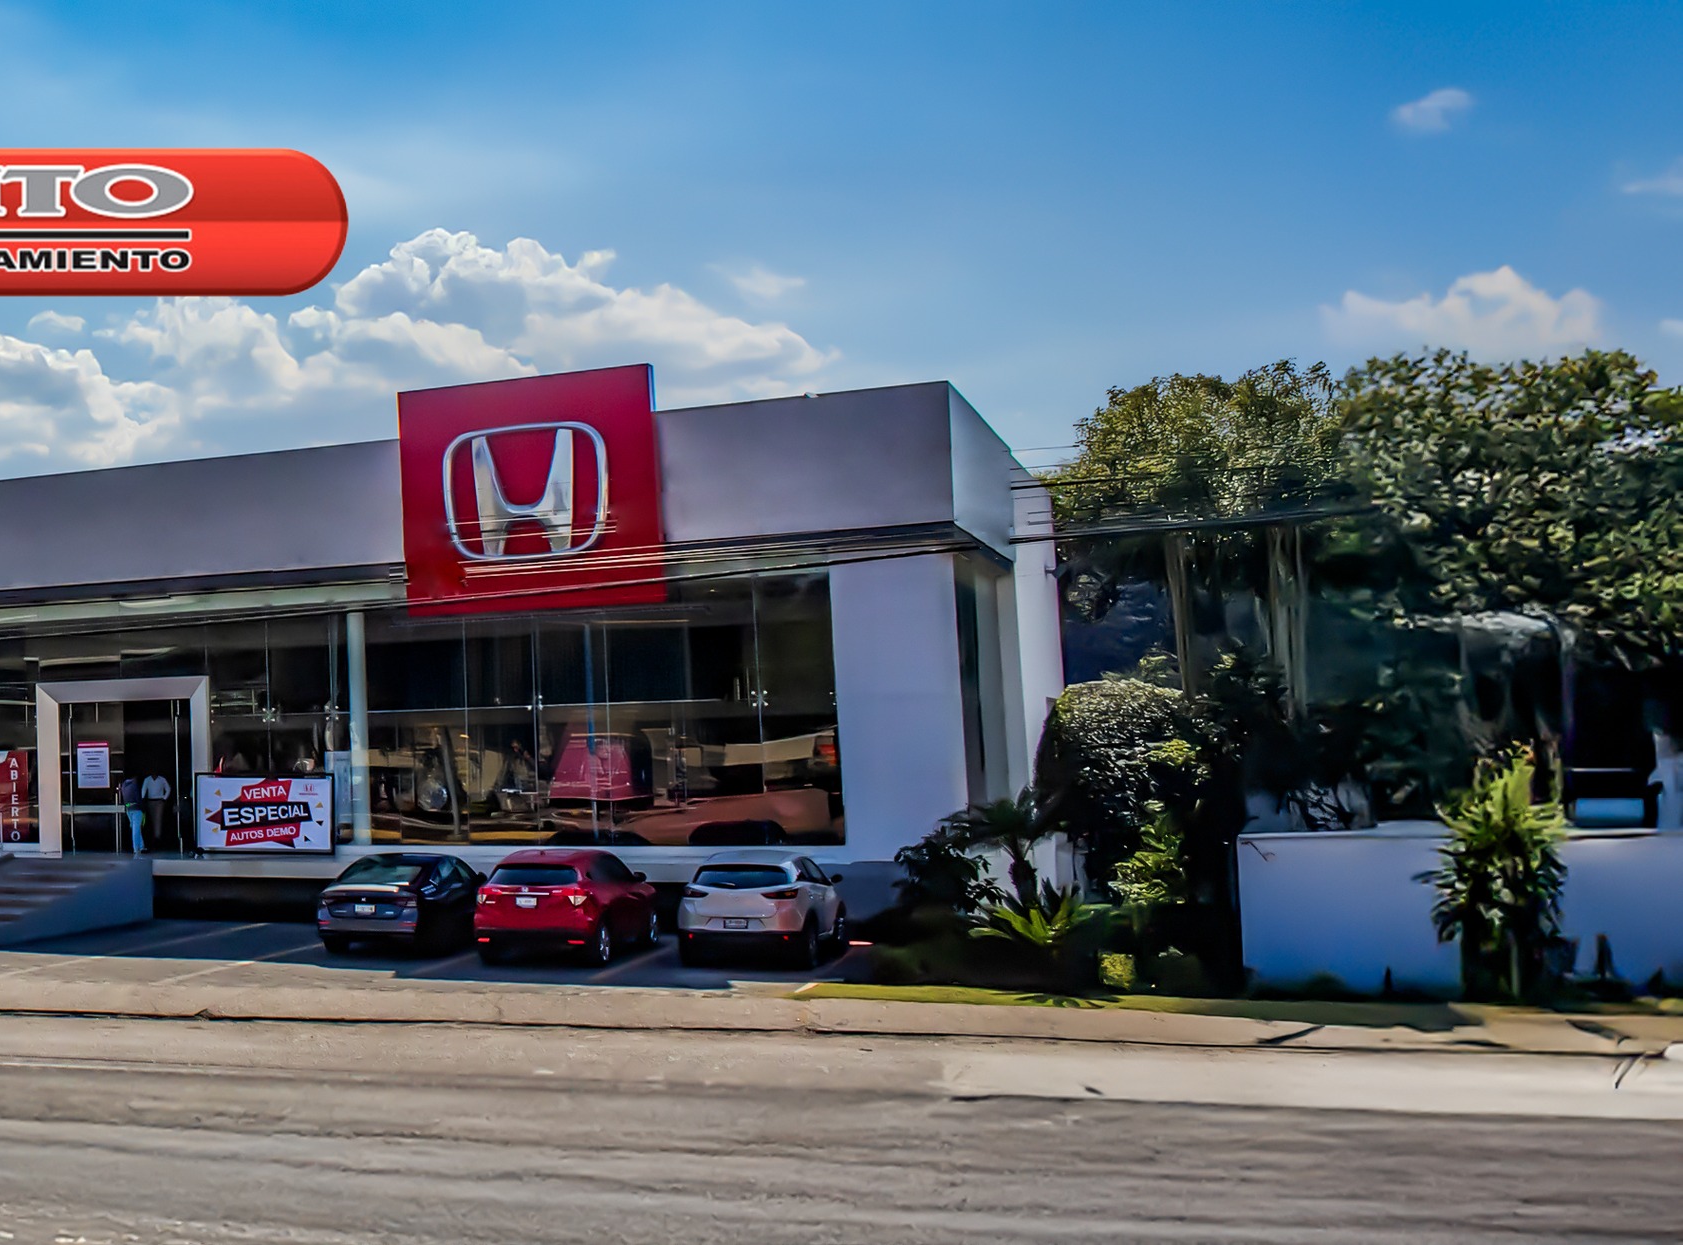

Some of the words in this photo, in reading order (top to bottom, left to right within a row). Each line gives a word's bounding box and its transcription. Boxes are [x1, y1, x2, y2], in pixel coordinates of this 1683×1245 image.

[9, 757, 21, 841] ABIERTO
[243, 785, 287, 800] VENTA
[223, 804, 308, 826] ESPECIAL
[230, 829, 264, 842] AUTOS
[266, 825, 296, 838] DEMO
